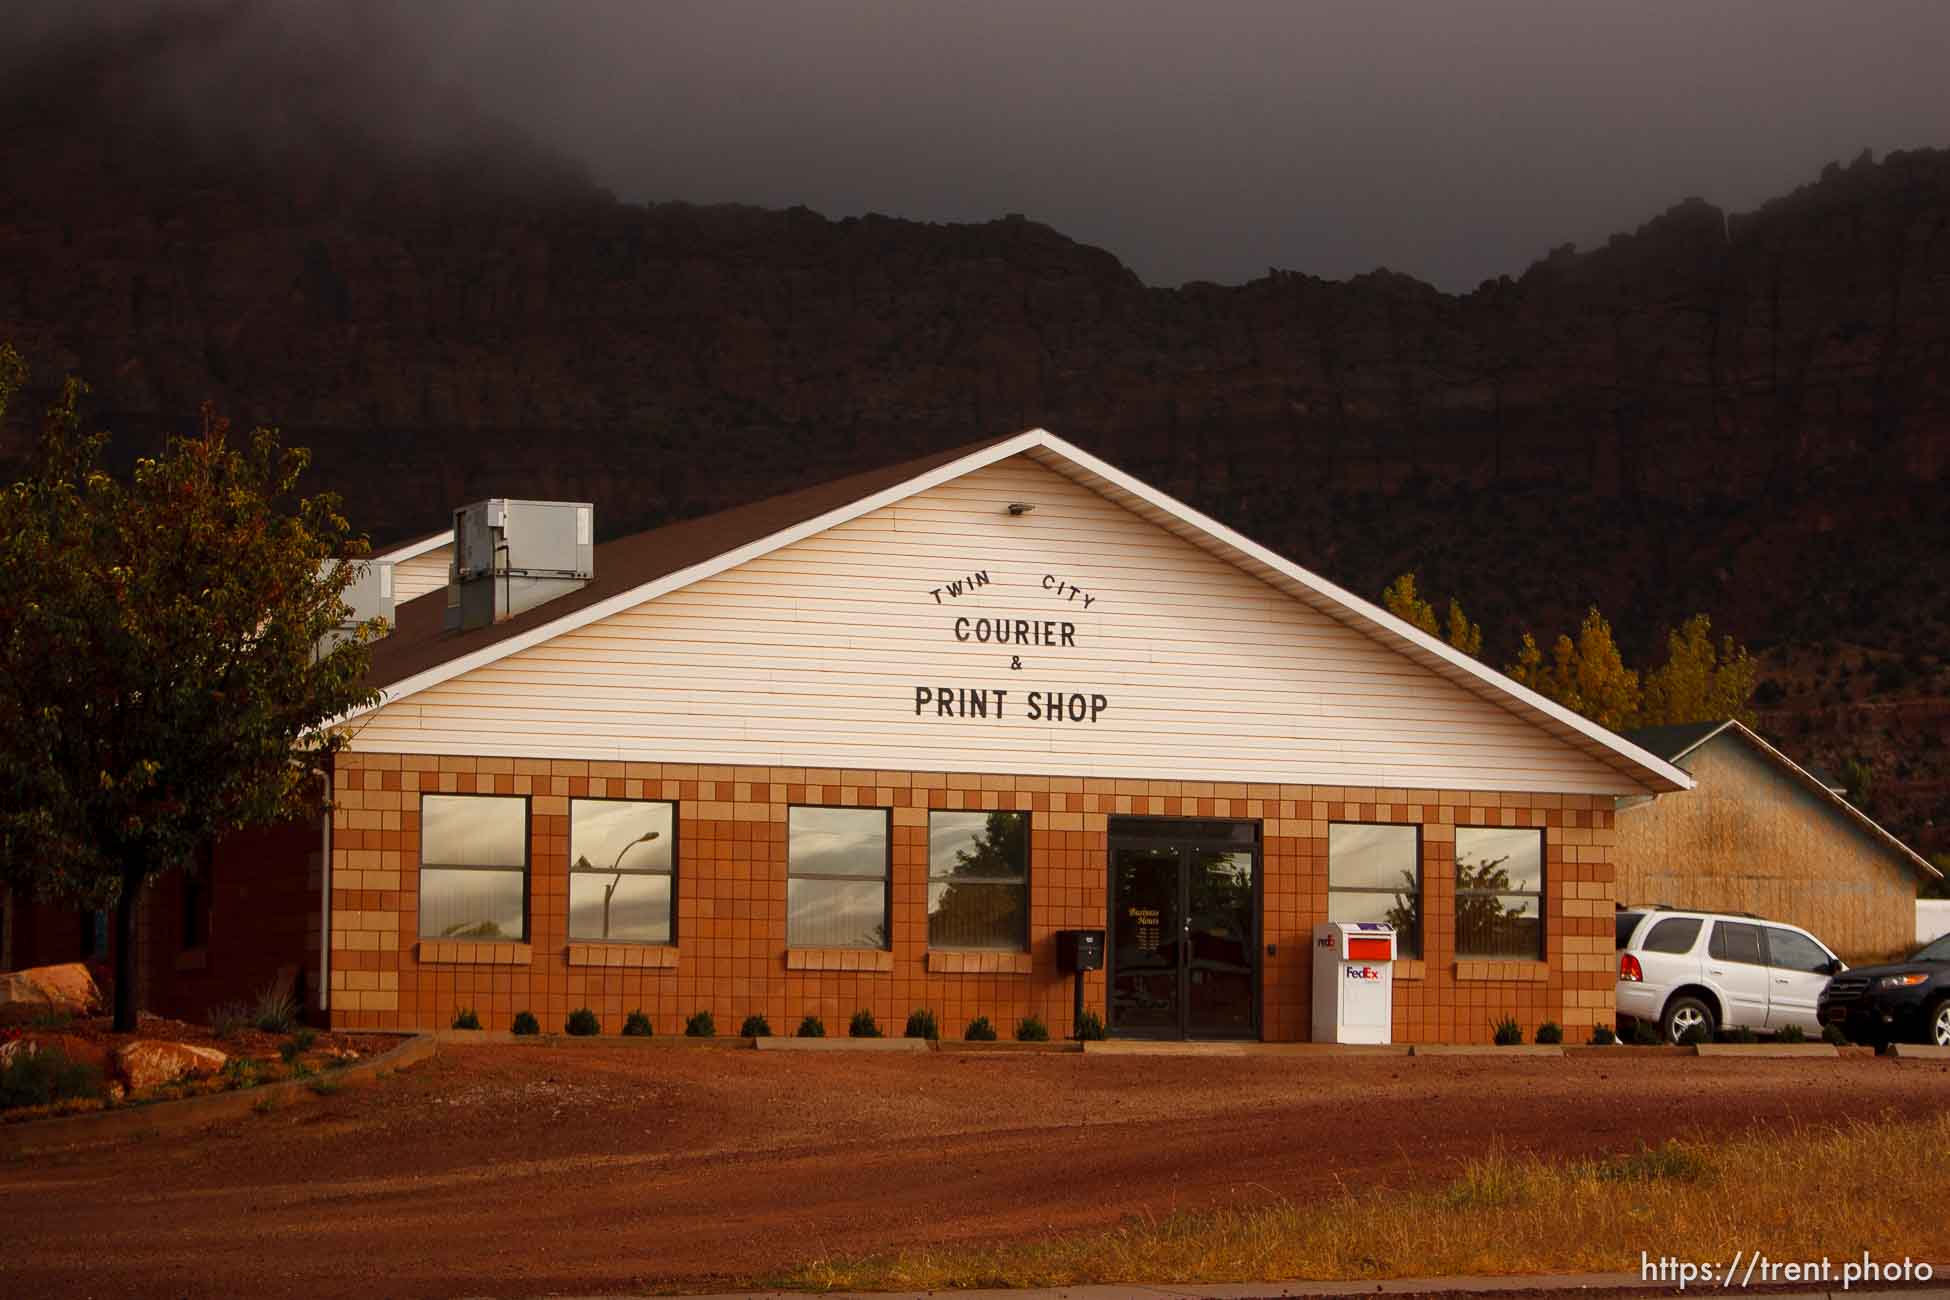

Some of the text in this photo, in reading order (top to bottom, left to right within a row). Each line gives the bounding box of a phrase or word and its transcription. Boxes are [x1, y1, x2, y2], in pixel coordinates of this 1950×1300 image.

[930, 570, 1096, 609] TWIN CITY
[955, 617, 1076, 647] COURIER
[1011, 655, 1022, 670] &
[916, 686, 1108, 723] PRINT SHOP
[1346, 966, 1379, 979] FedEx
